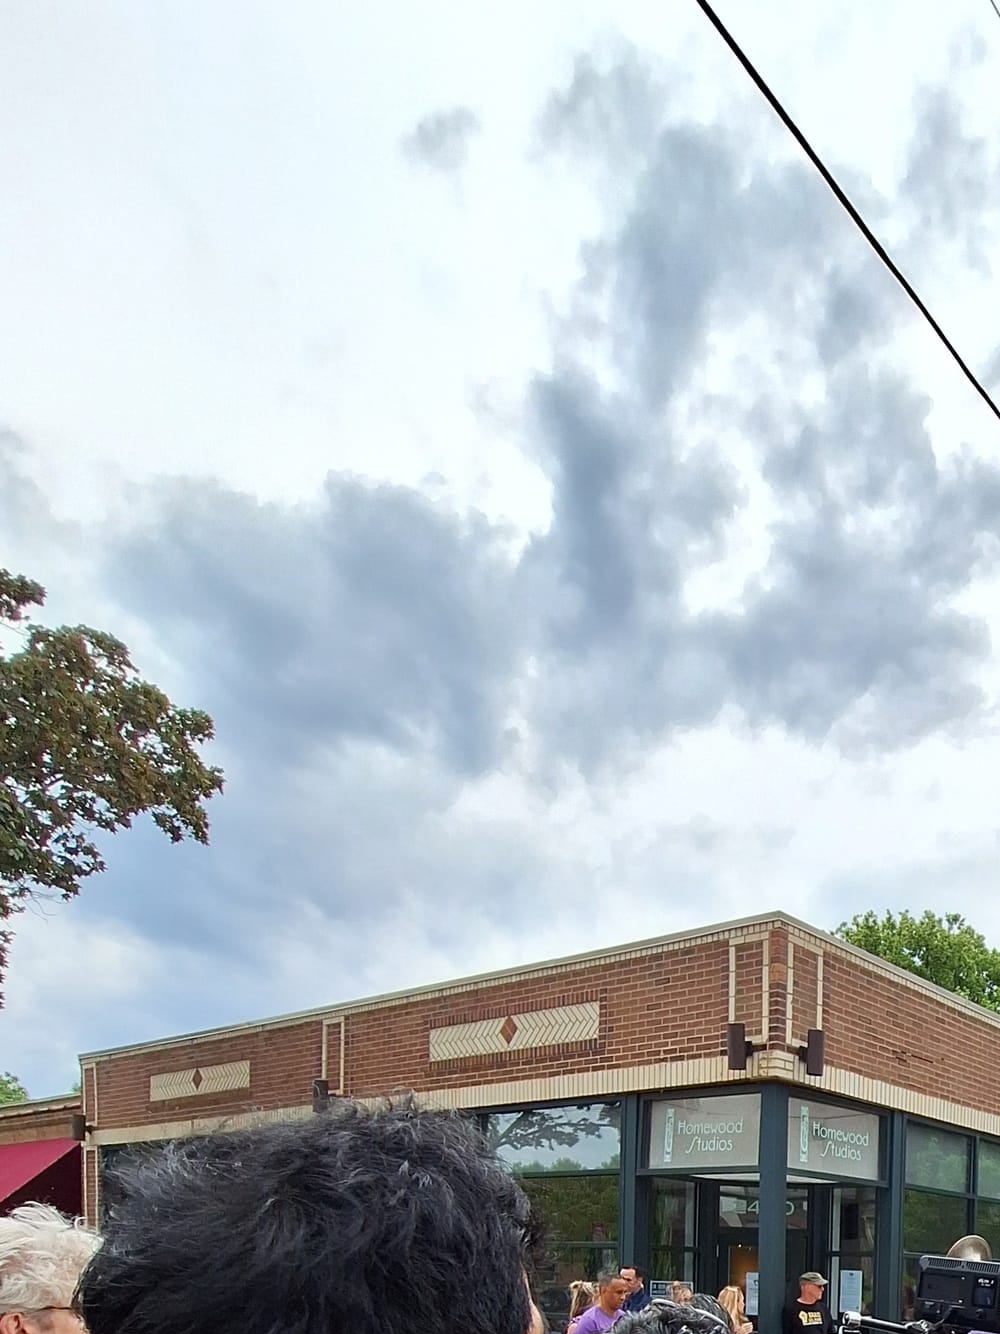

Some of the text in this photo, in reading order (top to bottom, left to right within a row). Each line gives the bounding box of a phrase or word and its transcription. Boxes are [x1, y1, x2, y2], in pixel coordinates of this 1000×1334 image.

[678, 1116, 743, 1135] Homewood
[812, 1121, 869, 1146] Homewood
[685, 1136, 733, 1154] Studios
[820, 1141, 862, 1161] Studios
